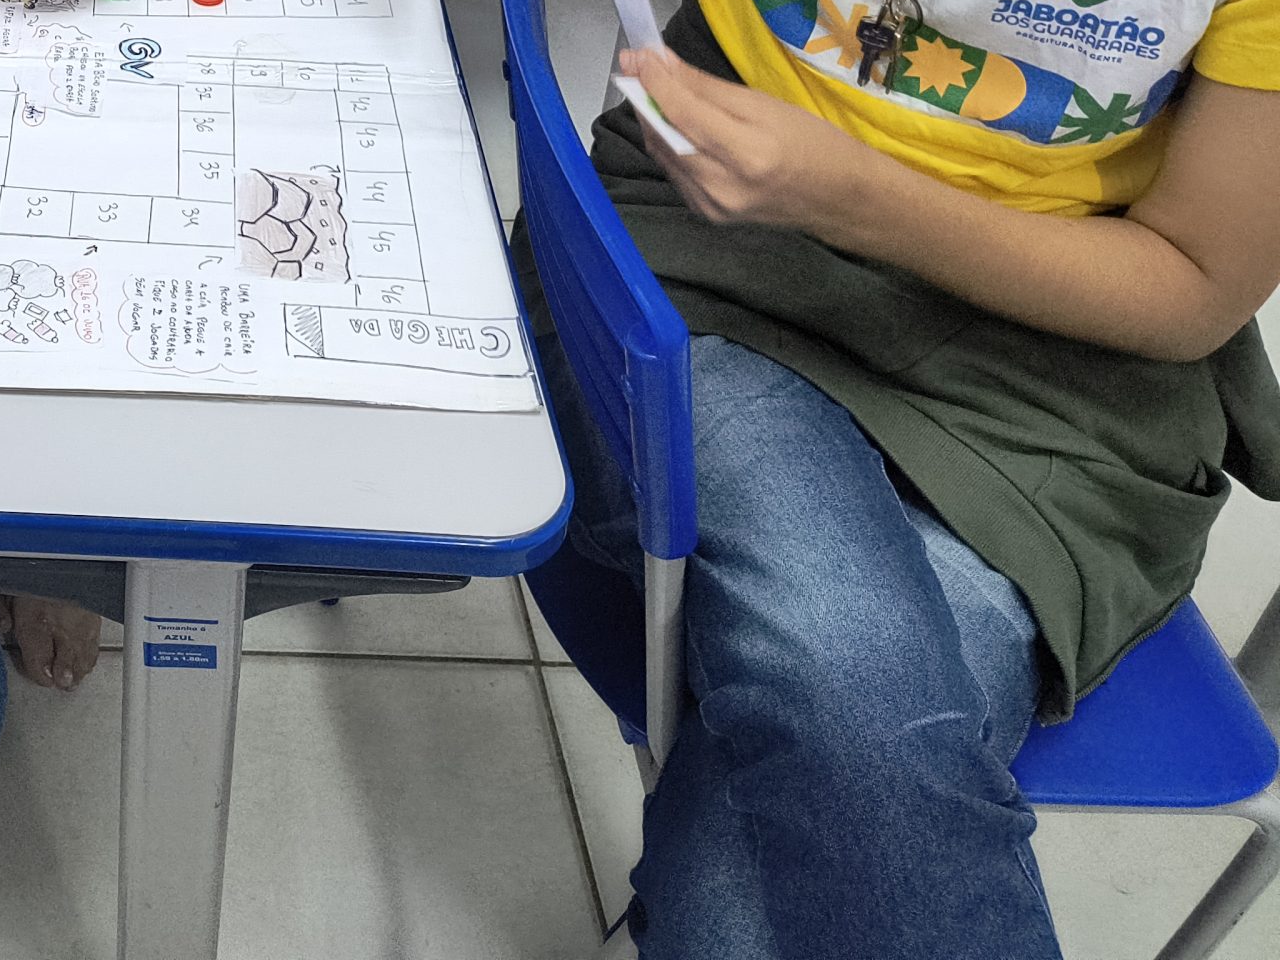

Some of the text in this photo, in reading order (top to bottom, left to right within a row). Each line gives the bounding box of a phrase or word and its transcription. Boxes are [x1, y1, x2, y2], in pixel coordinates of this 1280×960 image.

[993, 0, 1166, 47] JABOATÃO
[991, 12, 1161, 60] DOS GUARARAPES
[119, 37, 162, 79] GV
[349, 96, 371, 113] 42
[193, 117, 215, 133] 36
[356, 127, 379, 149] 43
[199, 161, 220, 180] 35
[363, 181, 388, 203] 44
[27, 196, 49, 218] 32
[98, 202, 119, 223] 33
[181, 207, 201, 228] 34
[369, 230, 396, 253] 45
[76, 271, 92, 288] RUA
[81, 291, 92, 301] 16
[237, 283, 251, 303] UMA
[381, 285, 405, 304] 46
[83, 304, 91, 314] DE
[131, 277, 146, 332] SEM JOGAR
[185, 305, 193, 316] DA
[148, 280, 166, 360] FIQUE 2 JOGADAS
[165, 279, 180, 362] CASO AO CONTRARIO
[196, 316, 208, 344] PEGUE
[219, 286, 233, 356] ACABOU DE CAIR
[349, 319, 512, 359] CHEGADA
[195, 348, 205, 357] A
[157, 624, 198, 632] Tamanho
